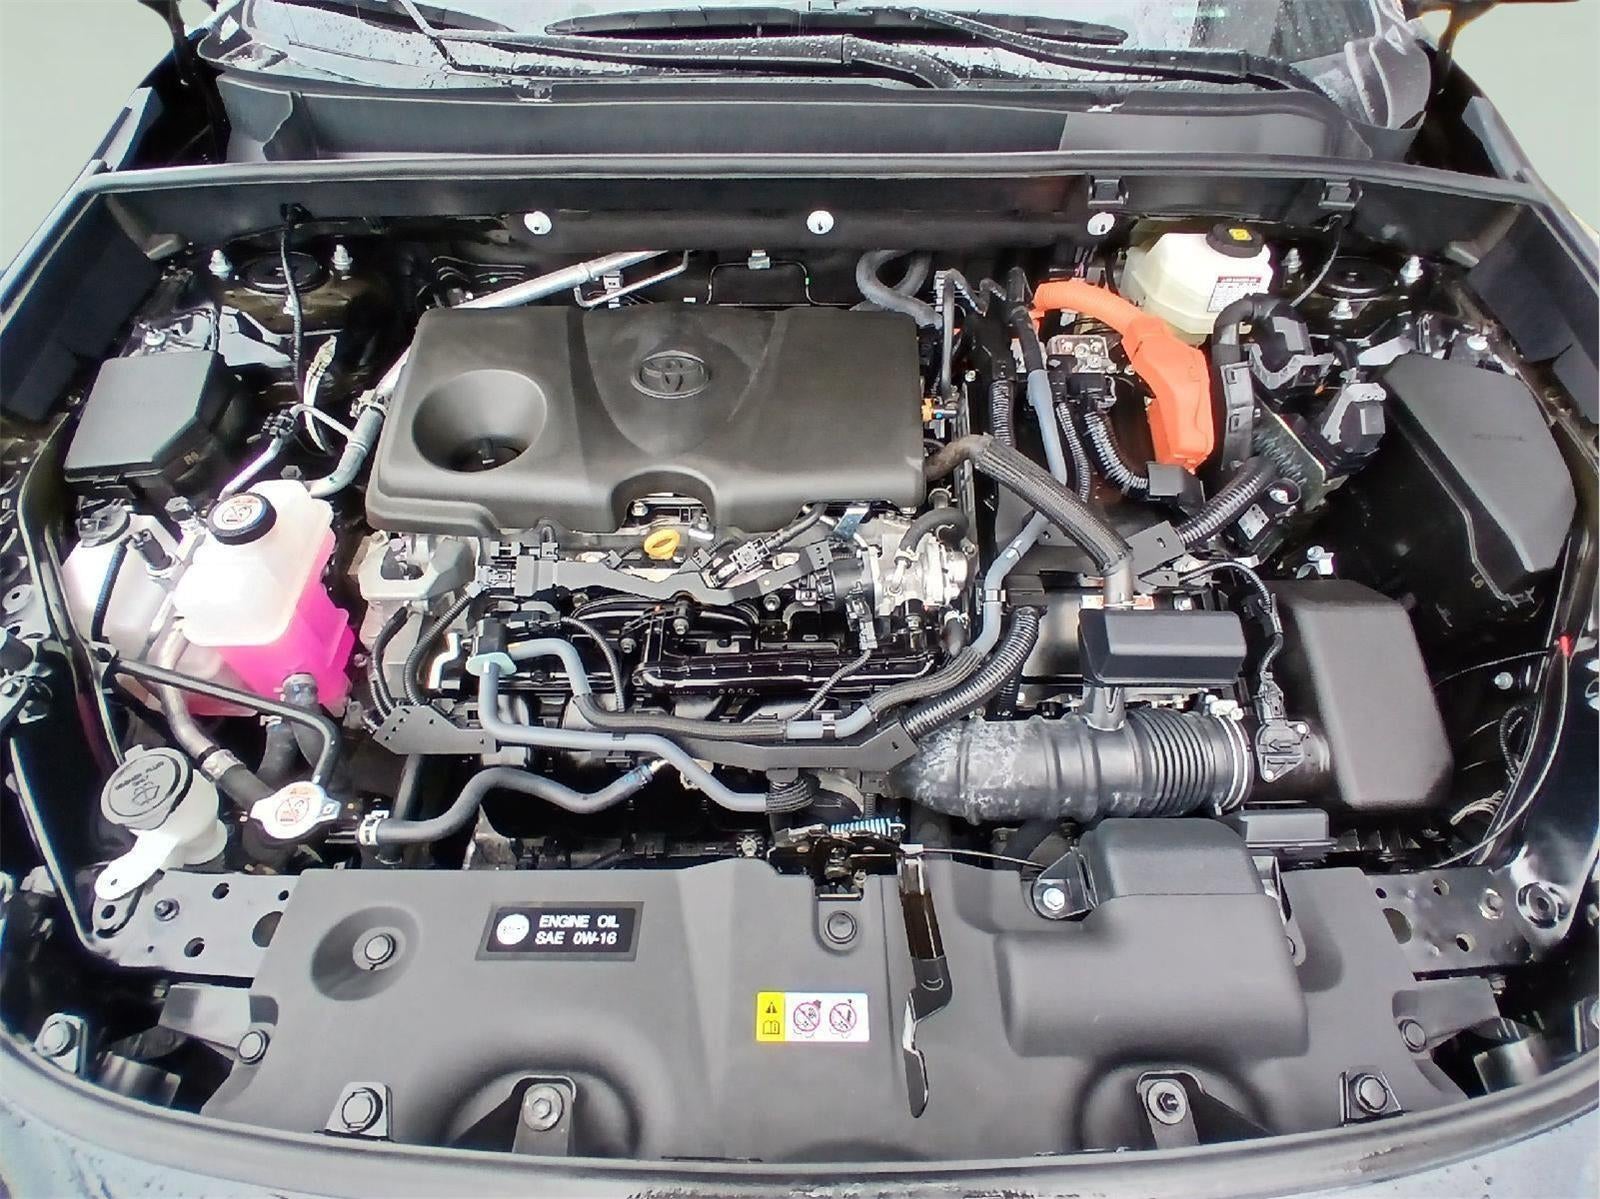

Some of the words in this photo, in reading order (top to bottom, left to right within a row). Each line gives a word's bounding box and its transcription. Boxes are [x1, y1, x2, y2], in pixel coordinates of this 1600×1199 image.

[539, 914, 591, 929] ENGINE
[597, 914, 620, 929] OIL
[534, 930, 566, 945] SAE
[572, 930, 618, 945] 0W-16
